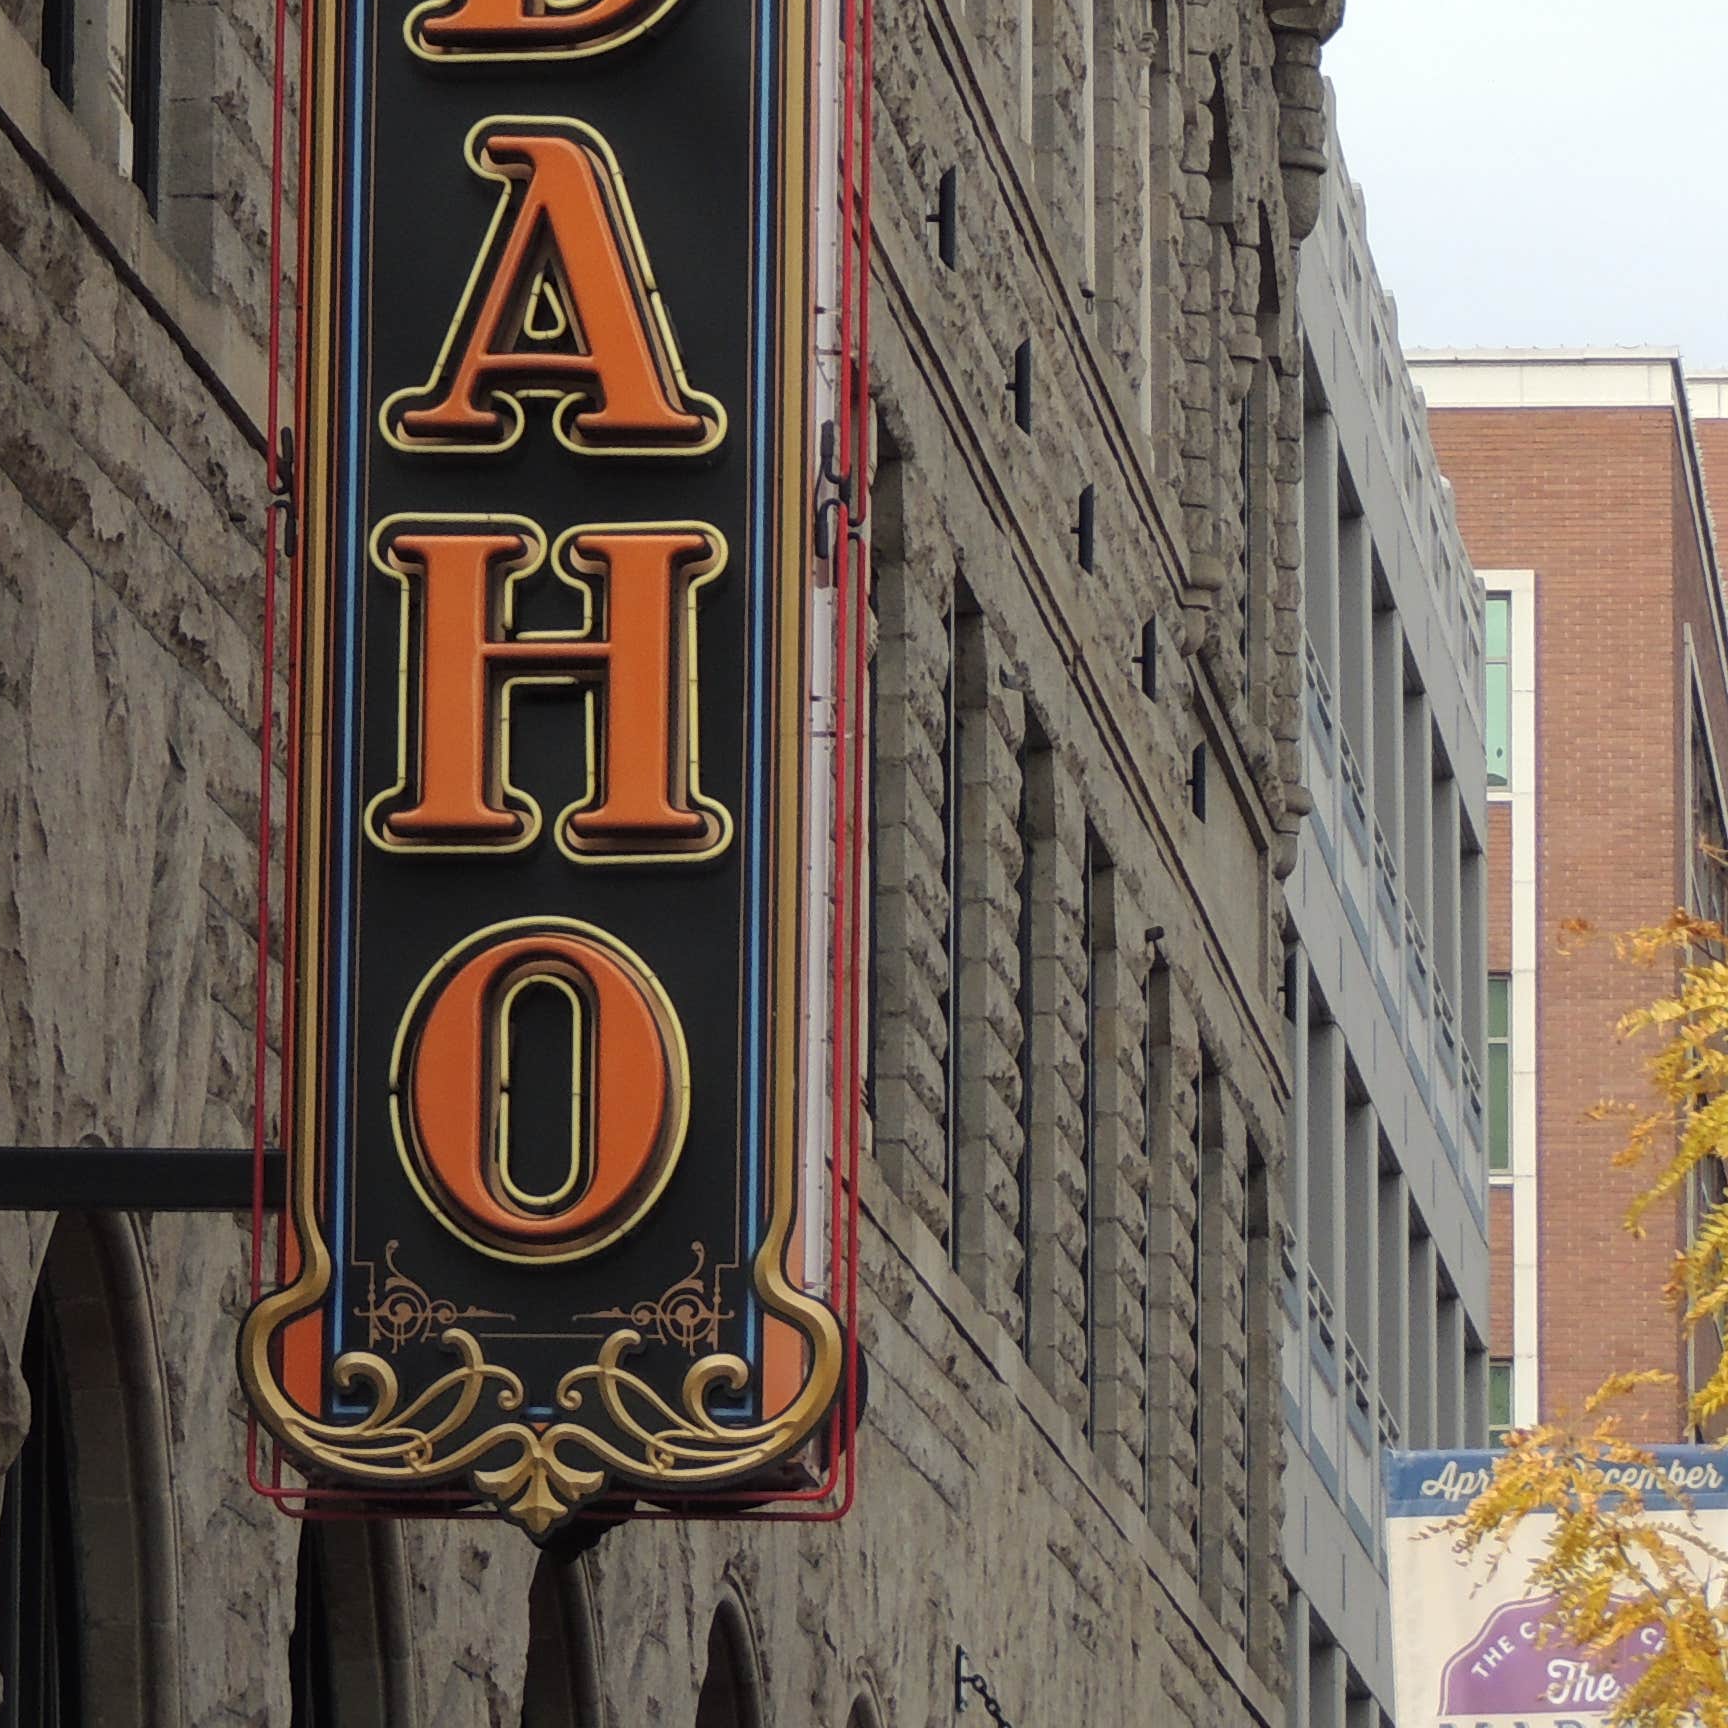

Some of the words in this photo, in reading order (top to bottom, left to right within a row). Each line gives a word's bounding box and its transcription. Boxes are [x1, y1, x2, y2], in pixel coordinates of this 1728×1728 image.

[1421, 1460, 1496, 1502] Apr
[1471, 1635, 1516, 1679] THE
[1546, 1658, 1622, 1705] The
